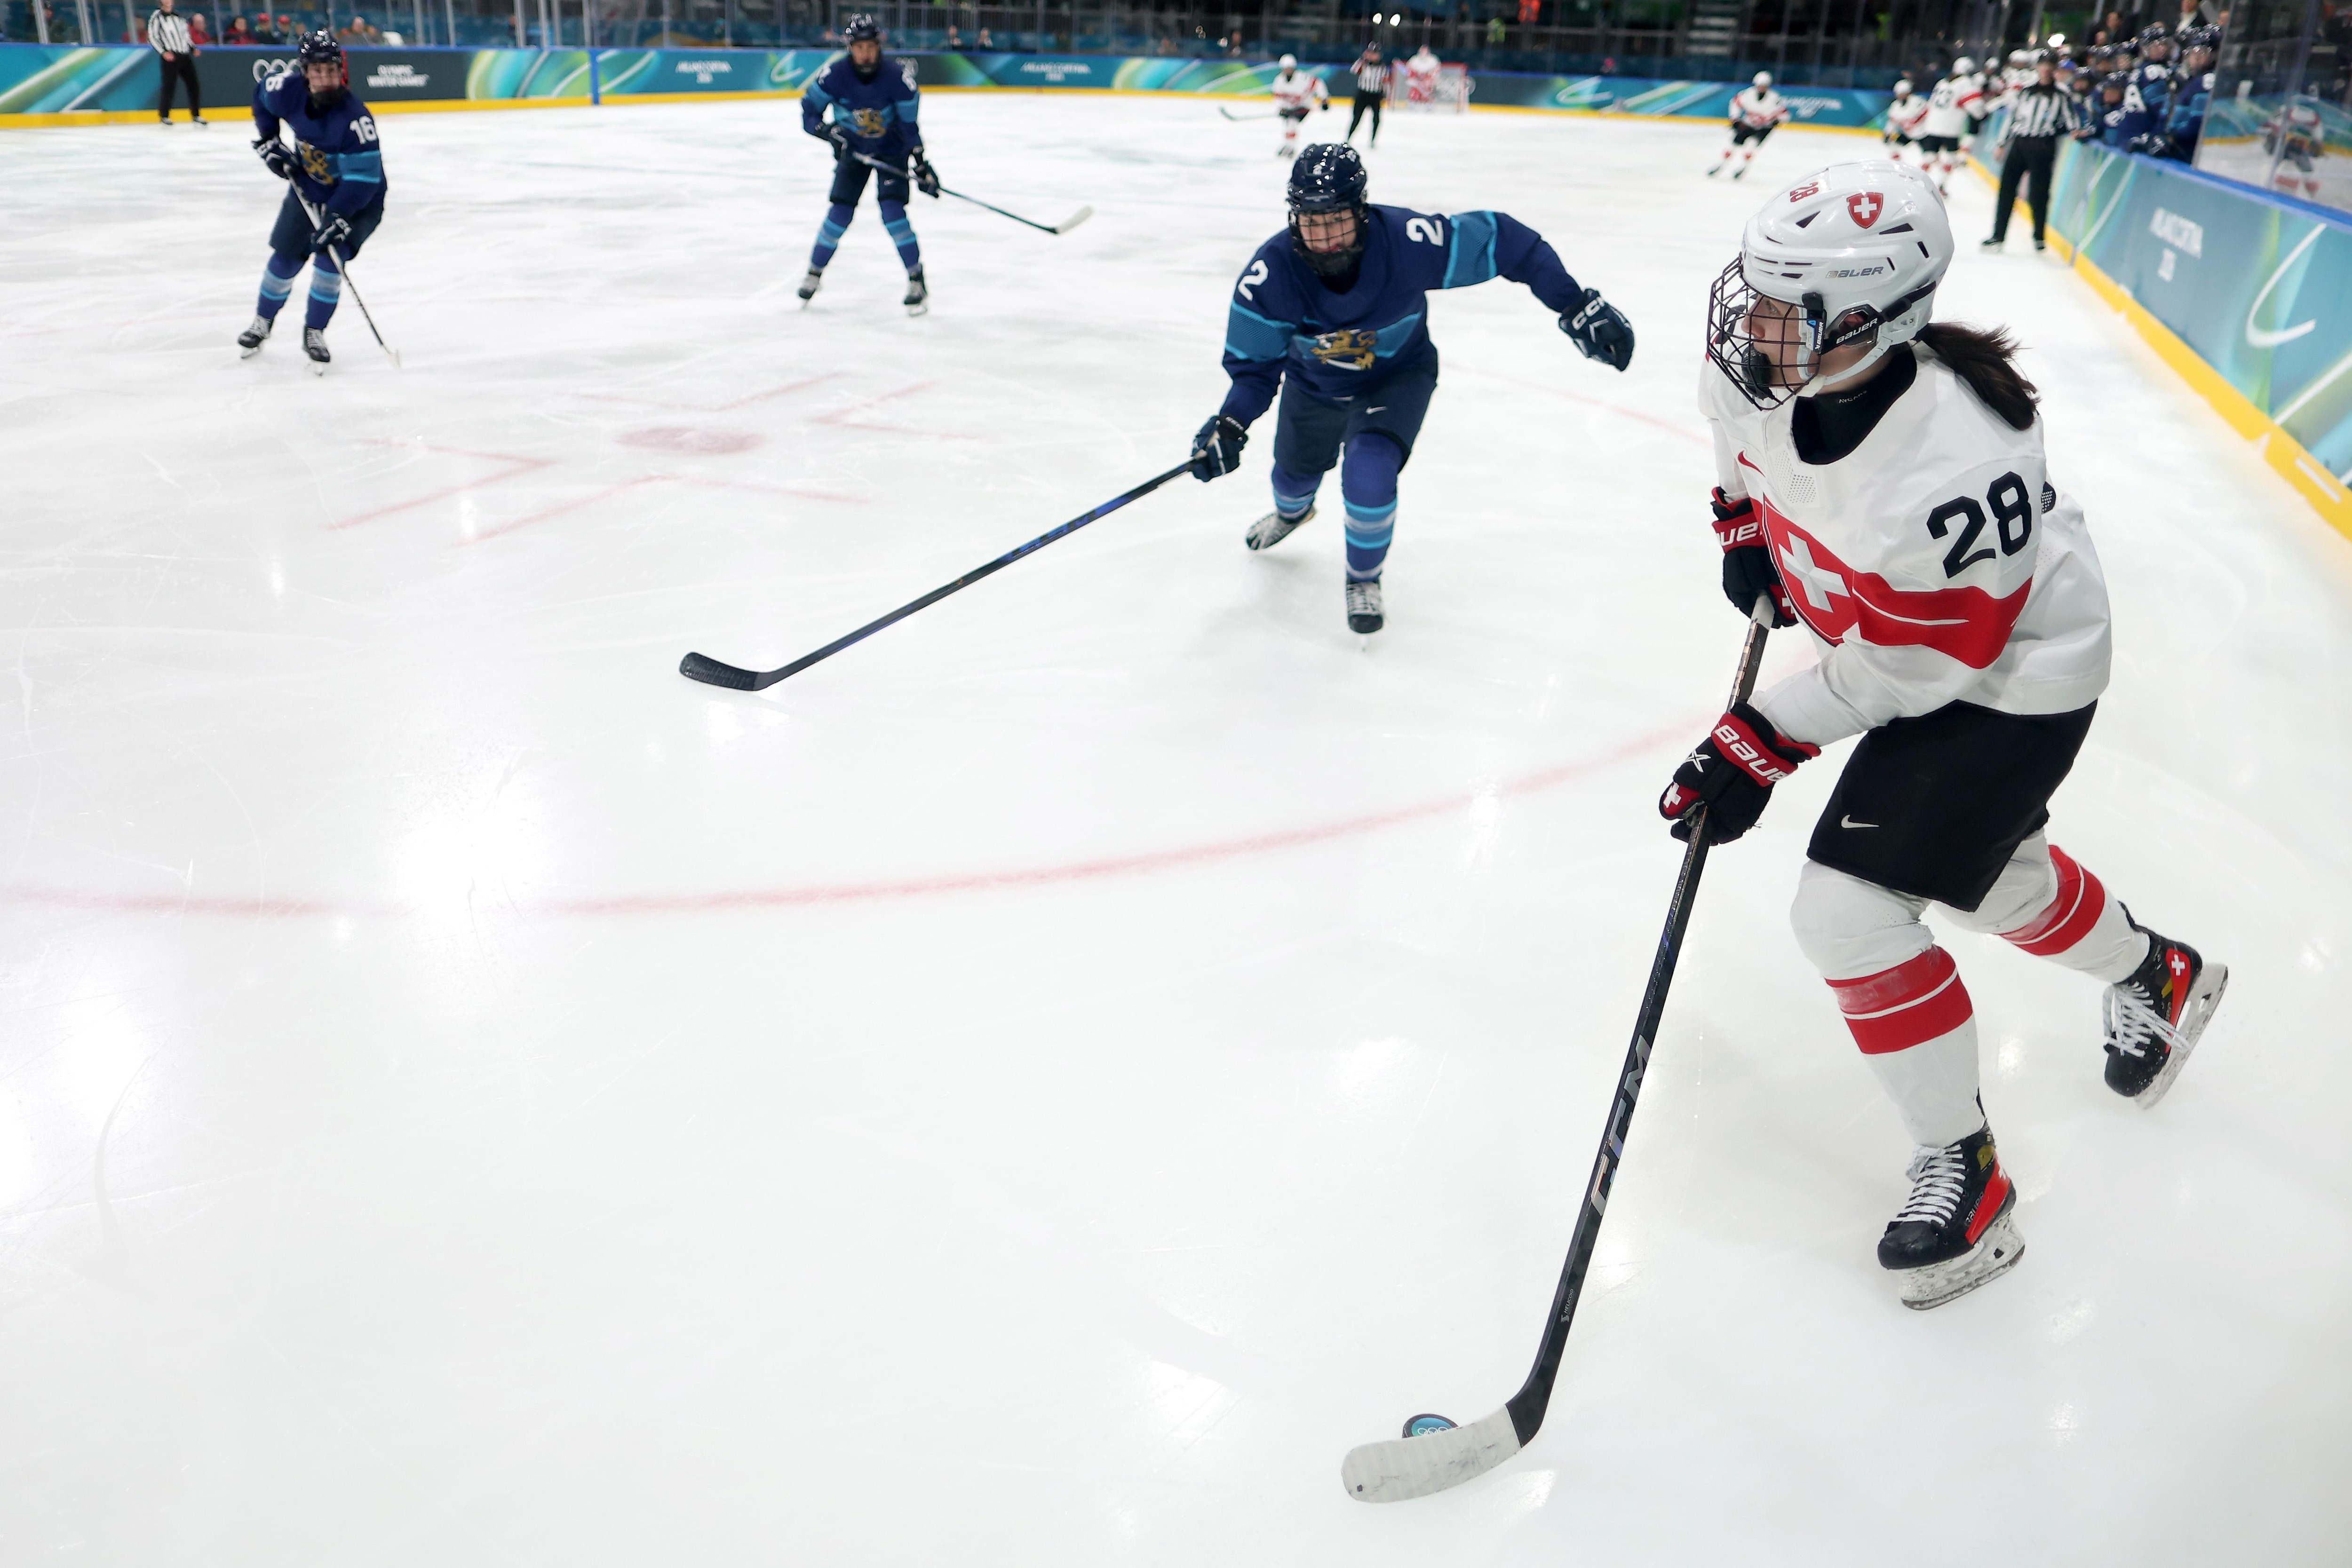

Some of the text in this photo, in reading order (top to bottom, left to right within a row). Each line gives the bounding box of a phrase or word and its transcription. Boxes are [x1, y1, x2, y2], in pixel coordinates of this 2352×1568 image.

[350, 116, 377, 145] 16
[1790, 182, 1819, 203] 28
[1406, 217, 1444, 247] 2
[1237, 259, 1269, 301] 2
[1826, 266, 1884, 278] BAUER
[1836, 317, 1878, 344] BAUER
[1926, 471, 2032, 579] 28
[1715, 725, 1788, 783] BAUE
[1588, 1034, 1652, 1217] CCM
[1564, 1289, 1574, 1314] HELICOID
